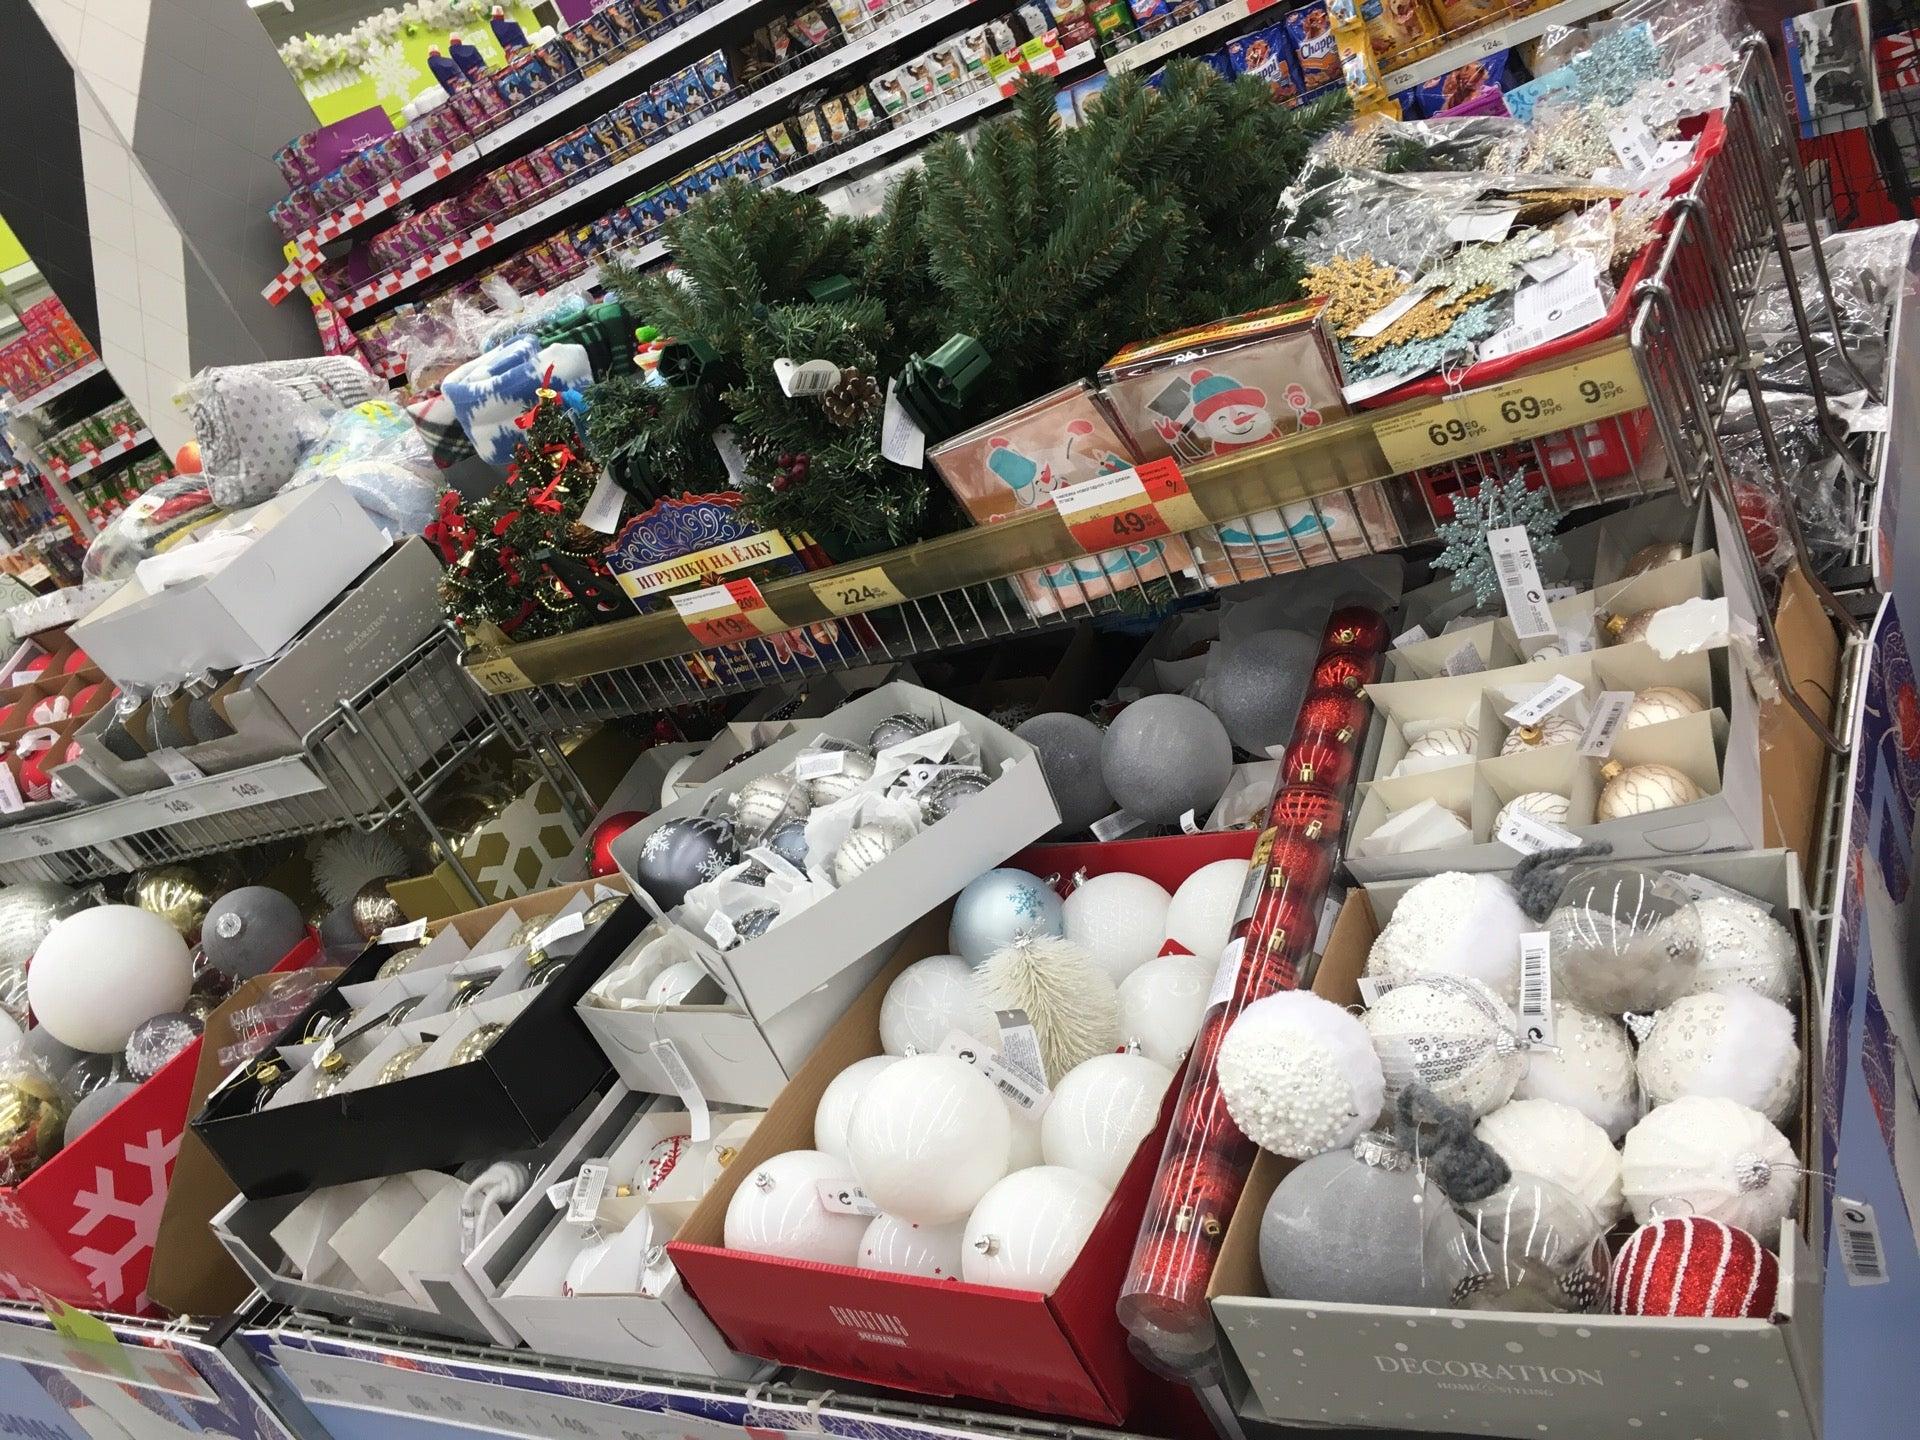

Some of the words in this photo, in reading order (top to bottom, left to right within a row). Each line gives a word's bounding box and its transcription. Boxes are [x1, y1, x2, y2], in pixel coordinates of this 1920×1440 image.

[1579, 380, 1601, 403] 9
[1501, 396, 1540, 423] 69
[1428, 419, 1467, 446] 69
[1113, 512, 1146, 535] 49
[636, 558, 709, 590] ИГРУШКИ
[709, 552, 735, 569] НА
[732, 540, 772, 563] ЁЛКУ
[836, 585, 876, 605] 224
[706, 618, 743, 636] 119
[486, 670, 512, 686] 179
[232, 783, 258, 798] 149
[164, 800, 189, 814] 149
[829, 1304, 909, 1337] CHRISTMAS
[1373, 1355, 1604, 1386] DECORATION
